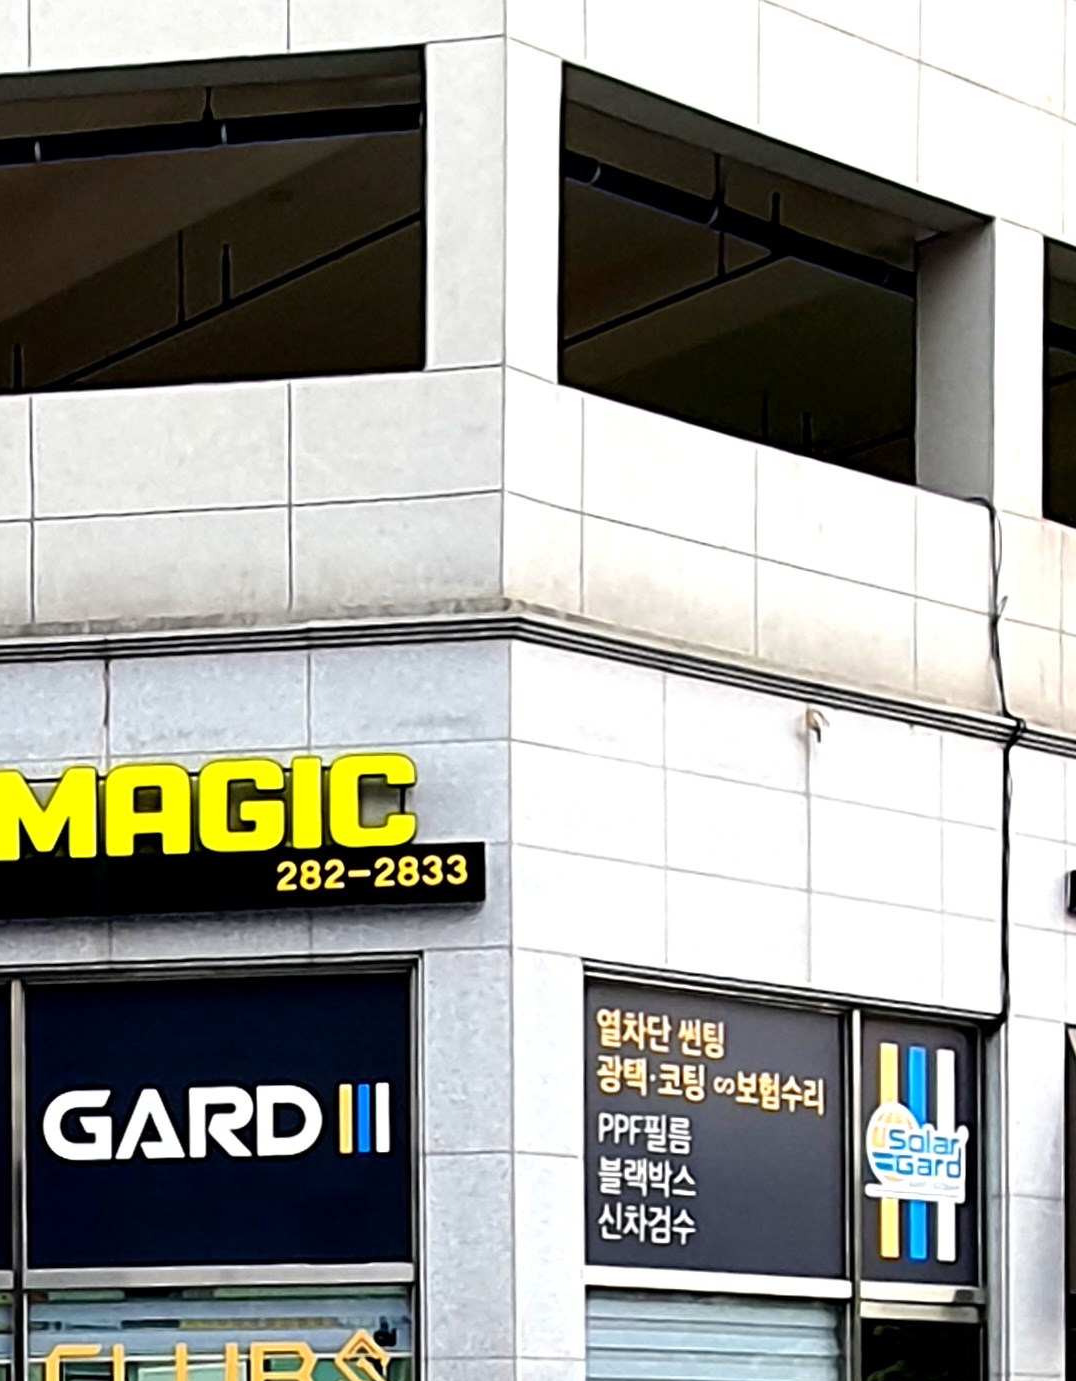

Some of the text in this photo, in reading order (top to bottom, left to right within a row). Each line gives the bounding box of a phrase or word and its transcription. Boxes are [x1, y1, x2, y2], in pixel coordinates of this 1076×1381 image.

[276, 854, 468, 891] 282-2833
[596, 1008, 725, 1059] 열차단 썬팅
[42, 1084, 322, 1160] GARD
[598, 1112, 692, 1155] PPF필름
[889, 1128, 960, 1155] Solar
[597, 1156, 697, 1198] 블랙박스
[896, 1146, 962, 1179] Gard
[597, 1201, 697, 1246] 신차검수
